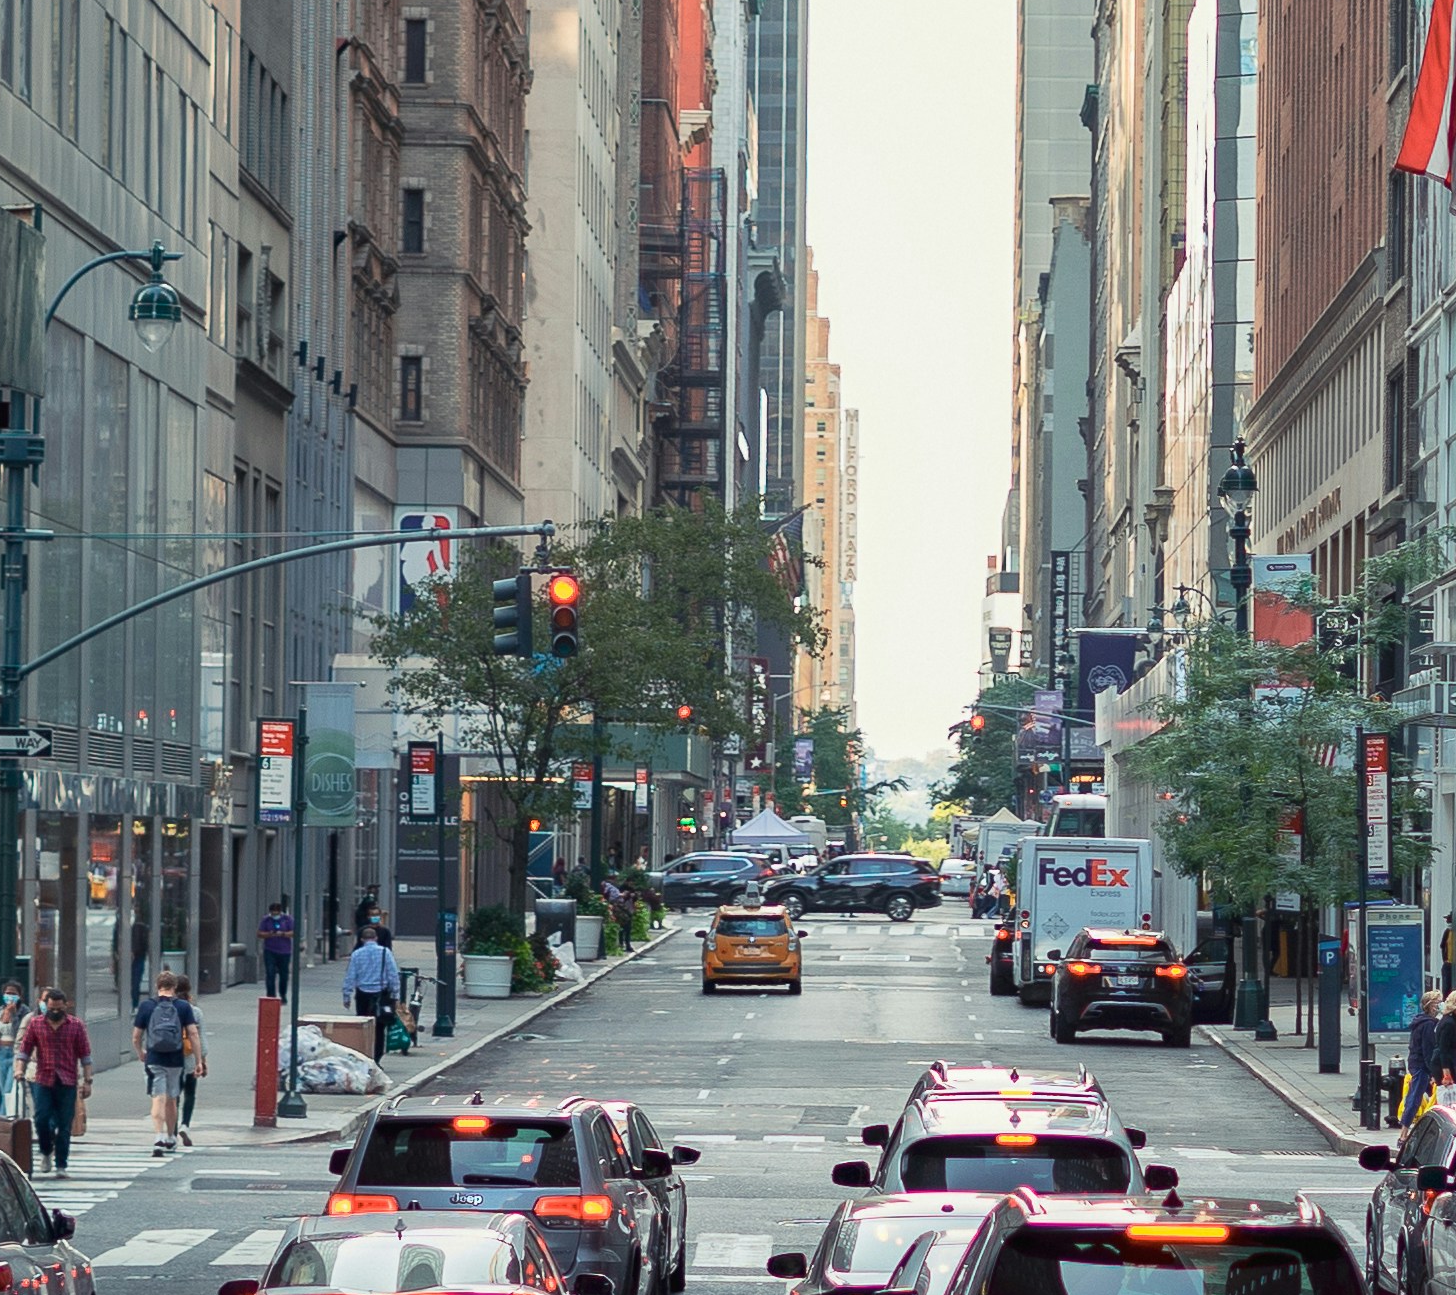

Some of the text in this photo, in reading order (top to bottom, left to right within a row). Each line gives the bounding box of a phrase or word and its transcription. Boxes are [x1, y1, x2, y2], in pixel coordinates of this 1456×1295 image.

[843, 512, 857, 581] PLAZA
[15, 737, 42, 749] WAY
[261, 757, 269, 769] 6
[311, 772, 352, 792] DISHES
[1038, 857, 1130, 888] FedEx
[1090, 889, 1122, 898] Express
[444, 921, 453, 933] P
[1326, 951, 1335, 964] P
[449, 1192, 483, 1205] Jeep
